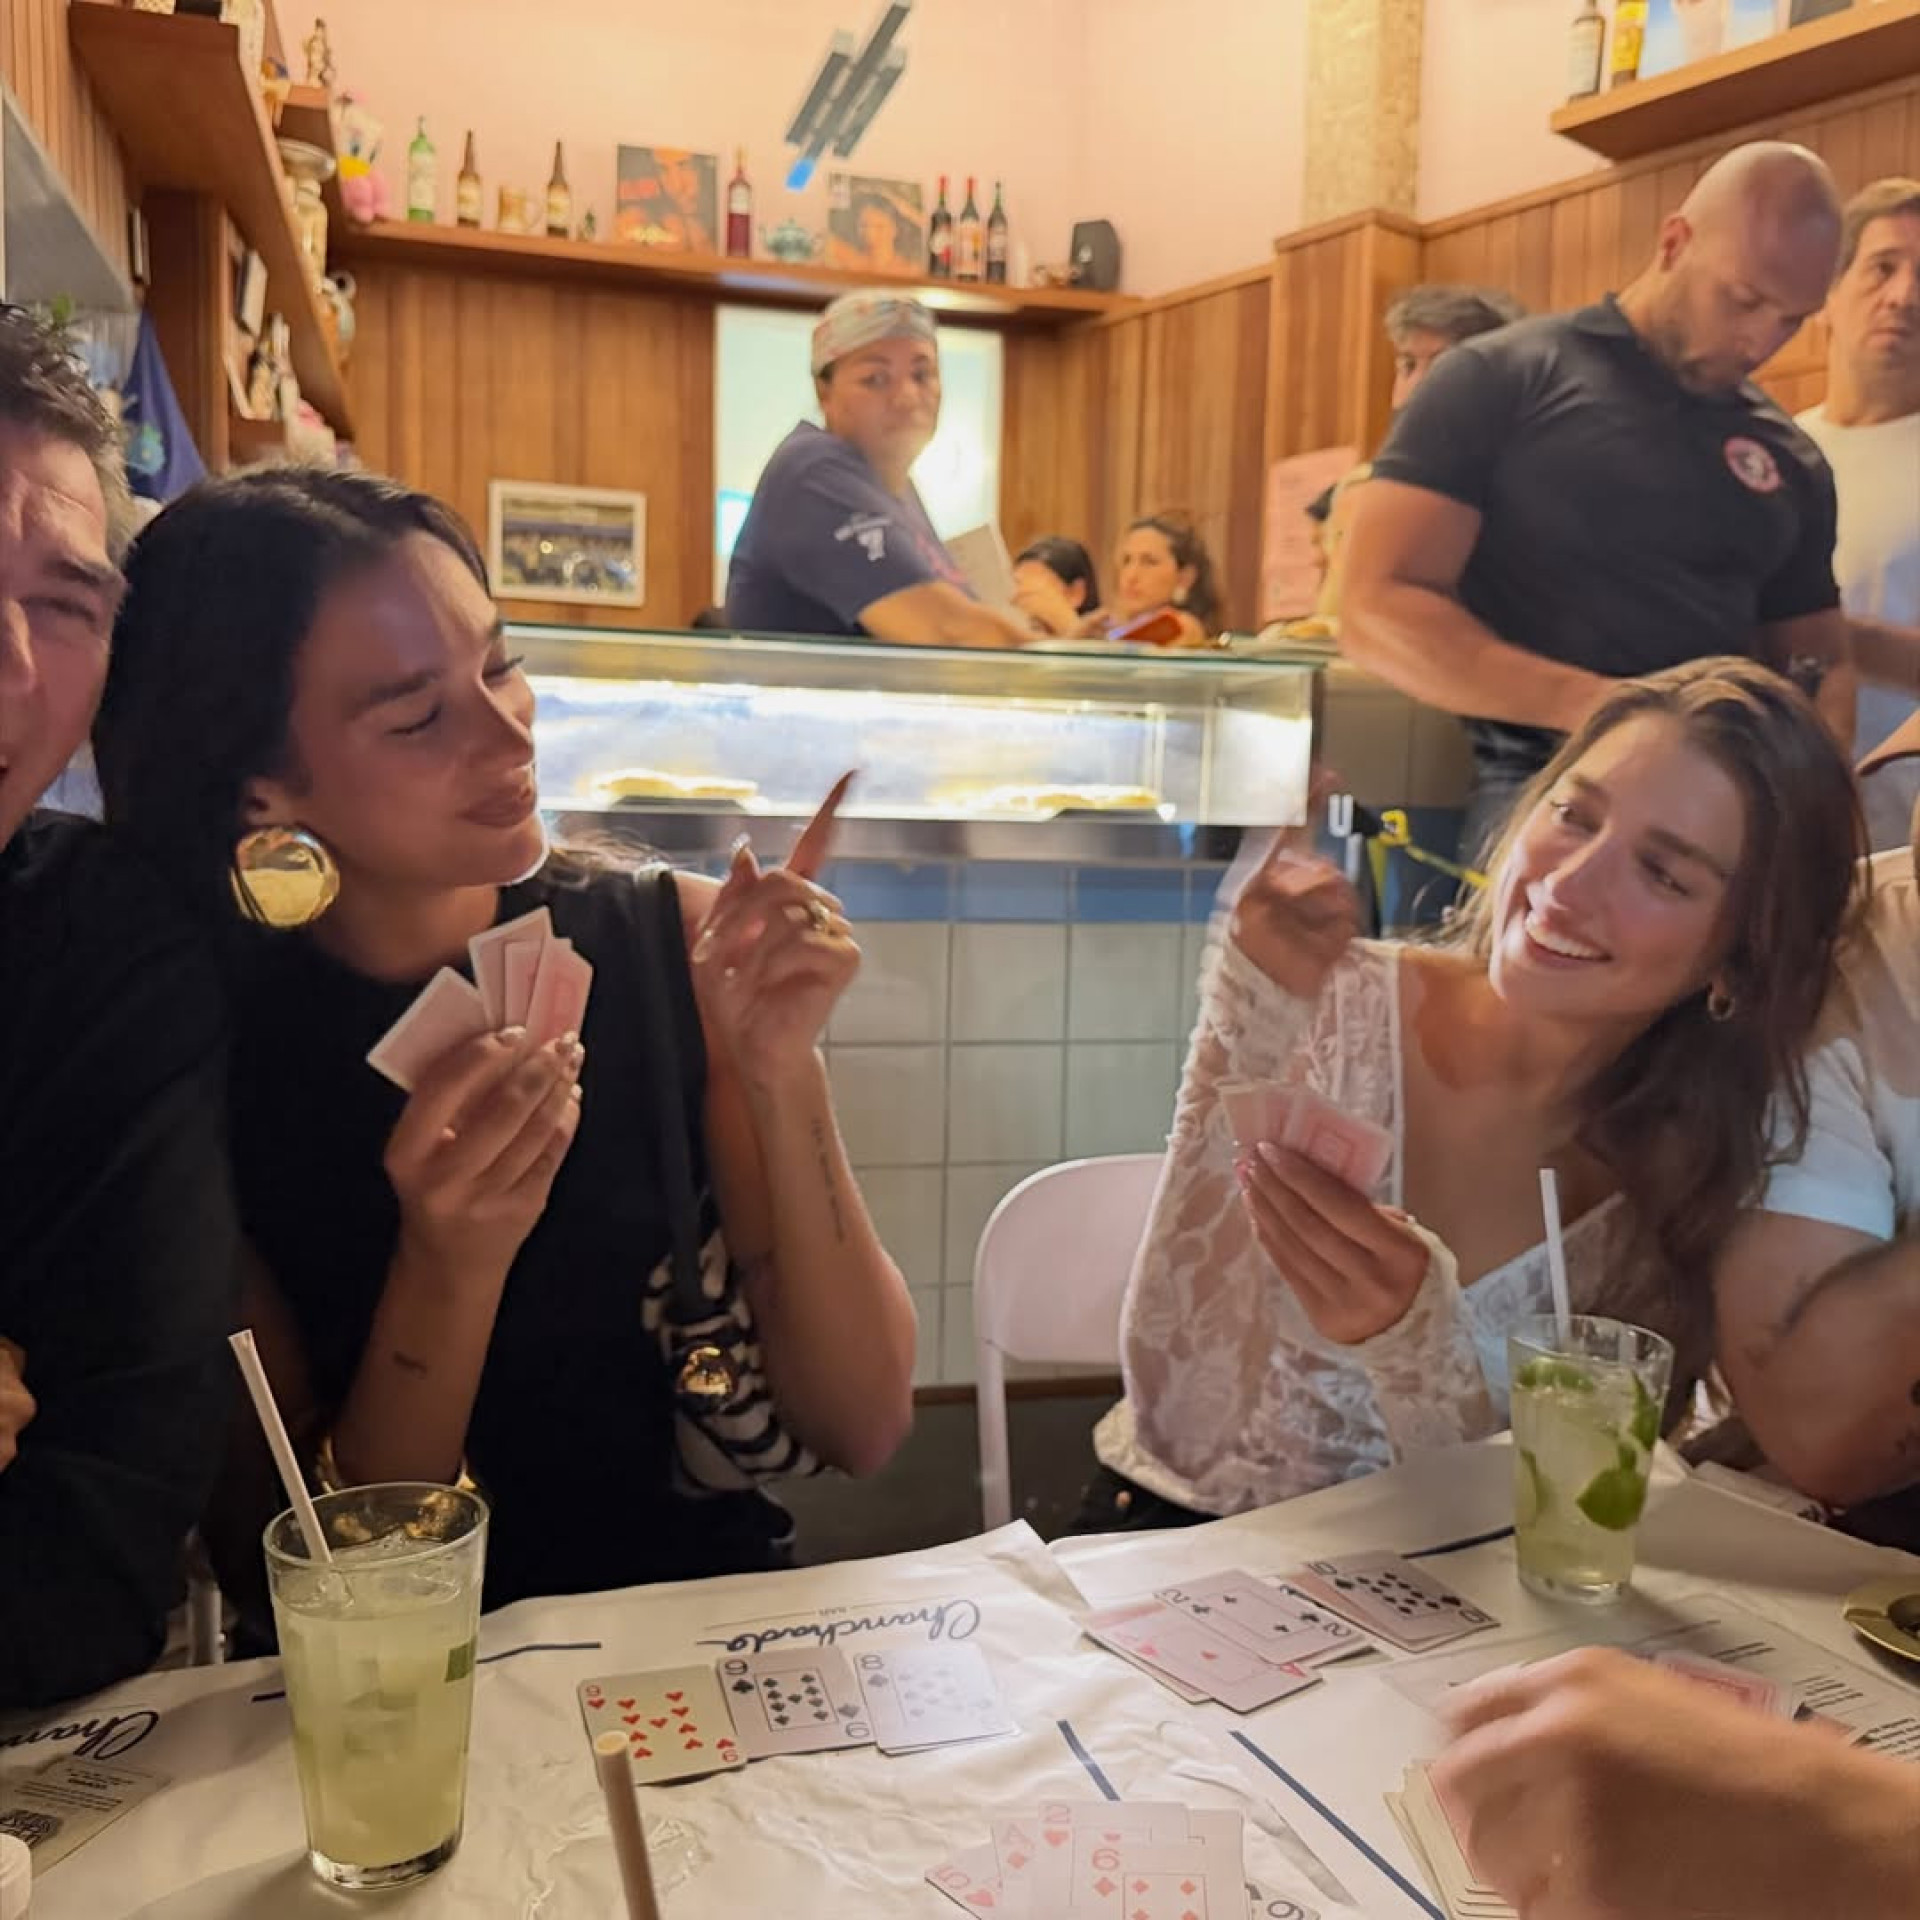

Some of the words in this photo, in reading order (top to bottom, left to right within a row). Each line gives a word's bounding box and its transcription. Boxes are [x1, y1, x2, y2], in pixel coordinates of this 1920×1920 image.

[1162, 1588, 1190, 1604] 2
[1322, 1621, 1350, 1637] 2
[724, 1658, 749, 1676] 9
[861, 1654, 885, 1670] 8
[585, 1684, 602, 1697] 9
[1043, 1803, 1071, 1824] 2
[1091, 1848, 1121, 1871] 6
[935, 1863, 972, 1891] 5
